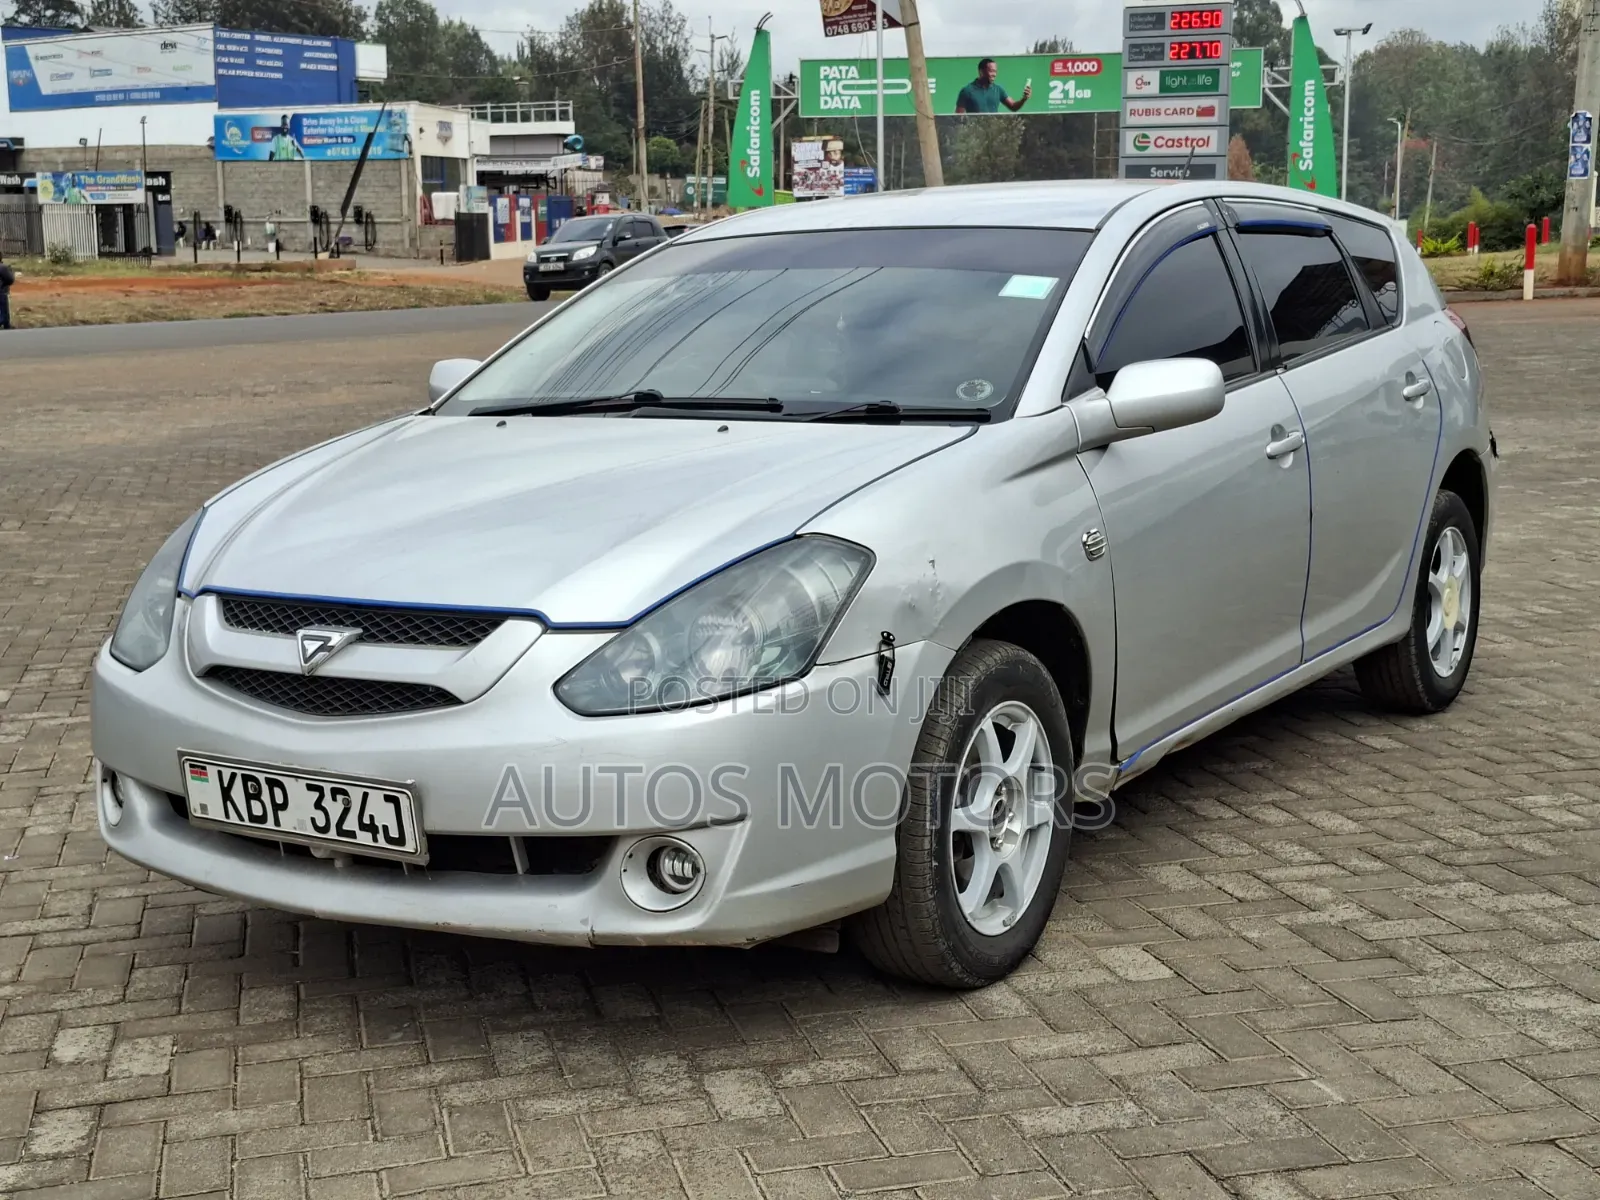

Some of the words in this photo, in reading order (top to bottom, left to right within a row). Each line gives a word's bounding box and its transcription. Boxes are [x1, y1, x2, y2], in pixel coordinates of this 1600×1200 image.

[1170, 11, 1222, 29] 226.90
[826, 24, 849, 36] 0748
[851, 22, 870, 32] 690
[871, 19, 889, 30] 33
[1169, 42, 1222, 59] 227.70
[819, 66, 859, 79] PATA
[1067, 61, 1098, 73] 1,000
[1165, 75, 1187, 88] light
[1197, 74, 1213, 85] life
[819, 96, 862, 109] DATA
[1164, 107, 1194, 116] CARD
[1299, 79, 1315, 171] Safaricom
[746, 90, 760, 178] Safaricom
[1153, 135, 1210, 148] Castrol
[146, 176, 166, 186] ash
[217, 769, 290, 828] KBP
[305, 782, 406, 847] 324J
